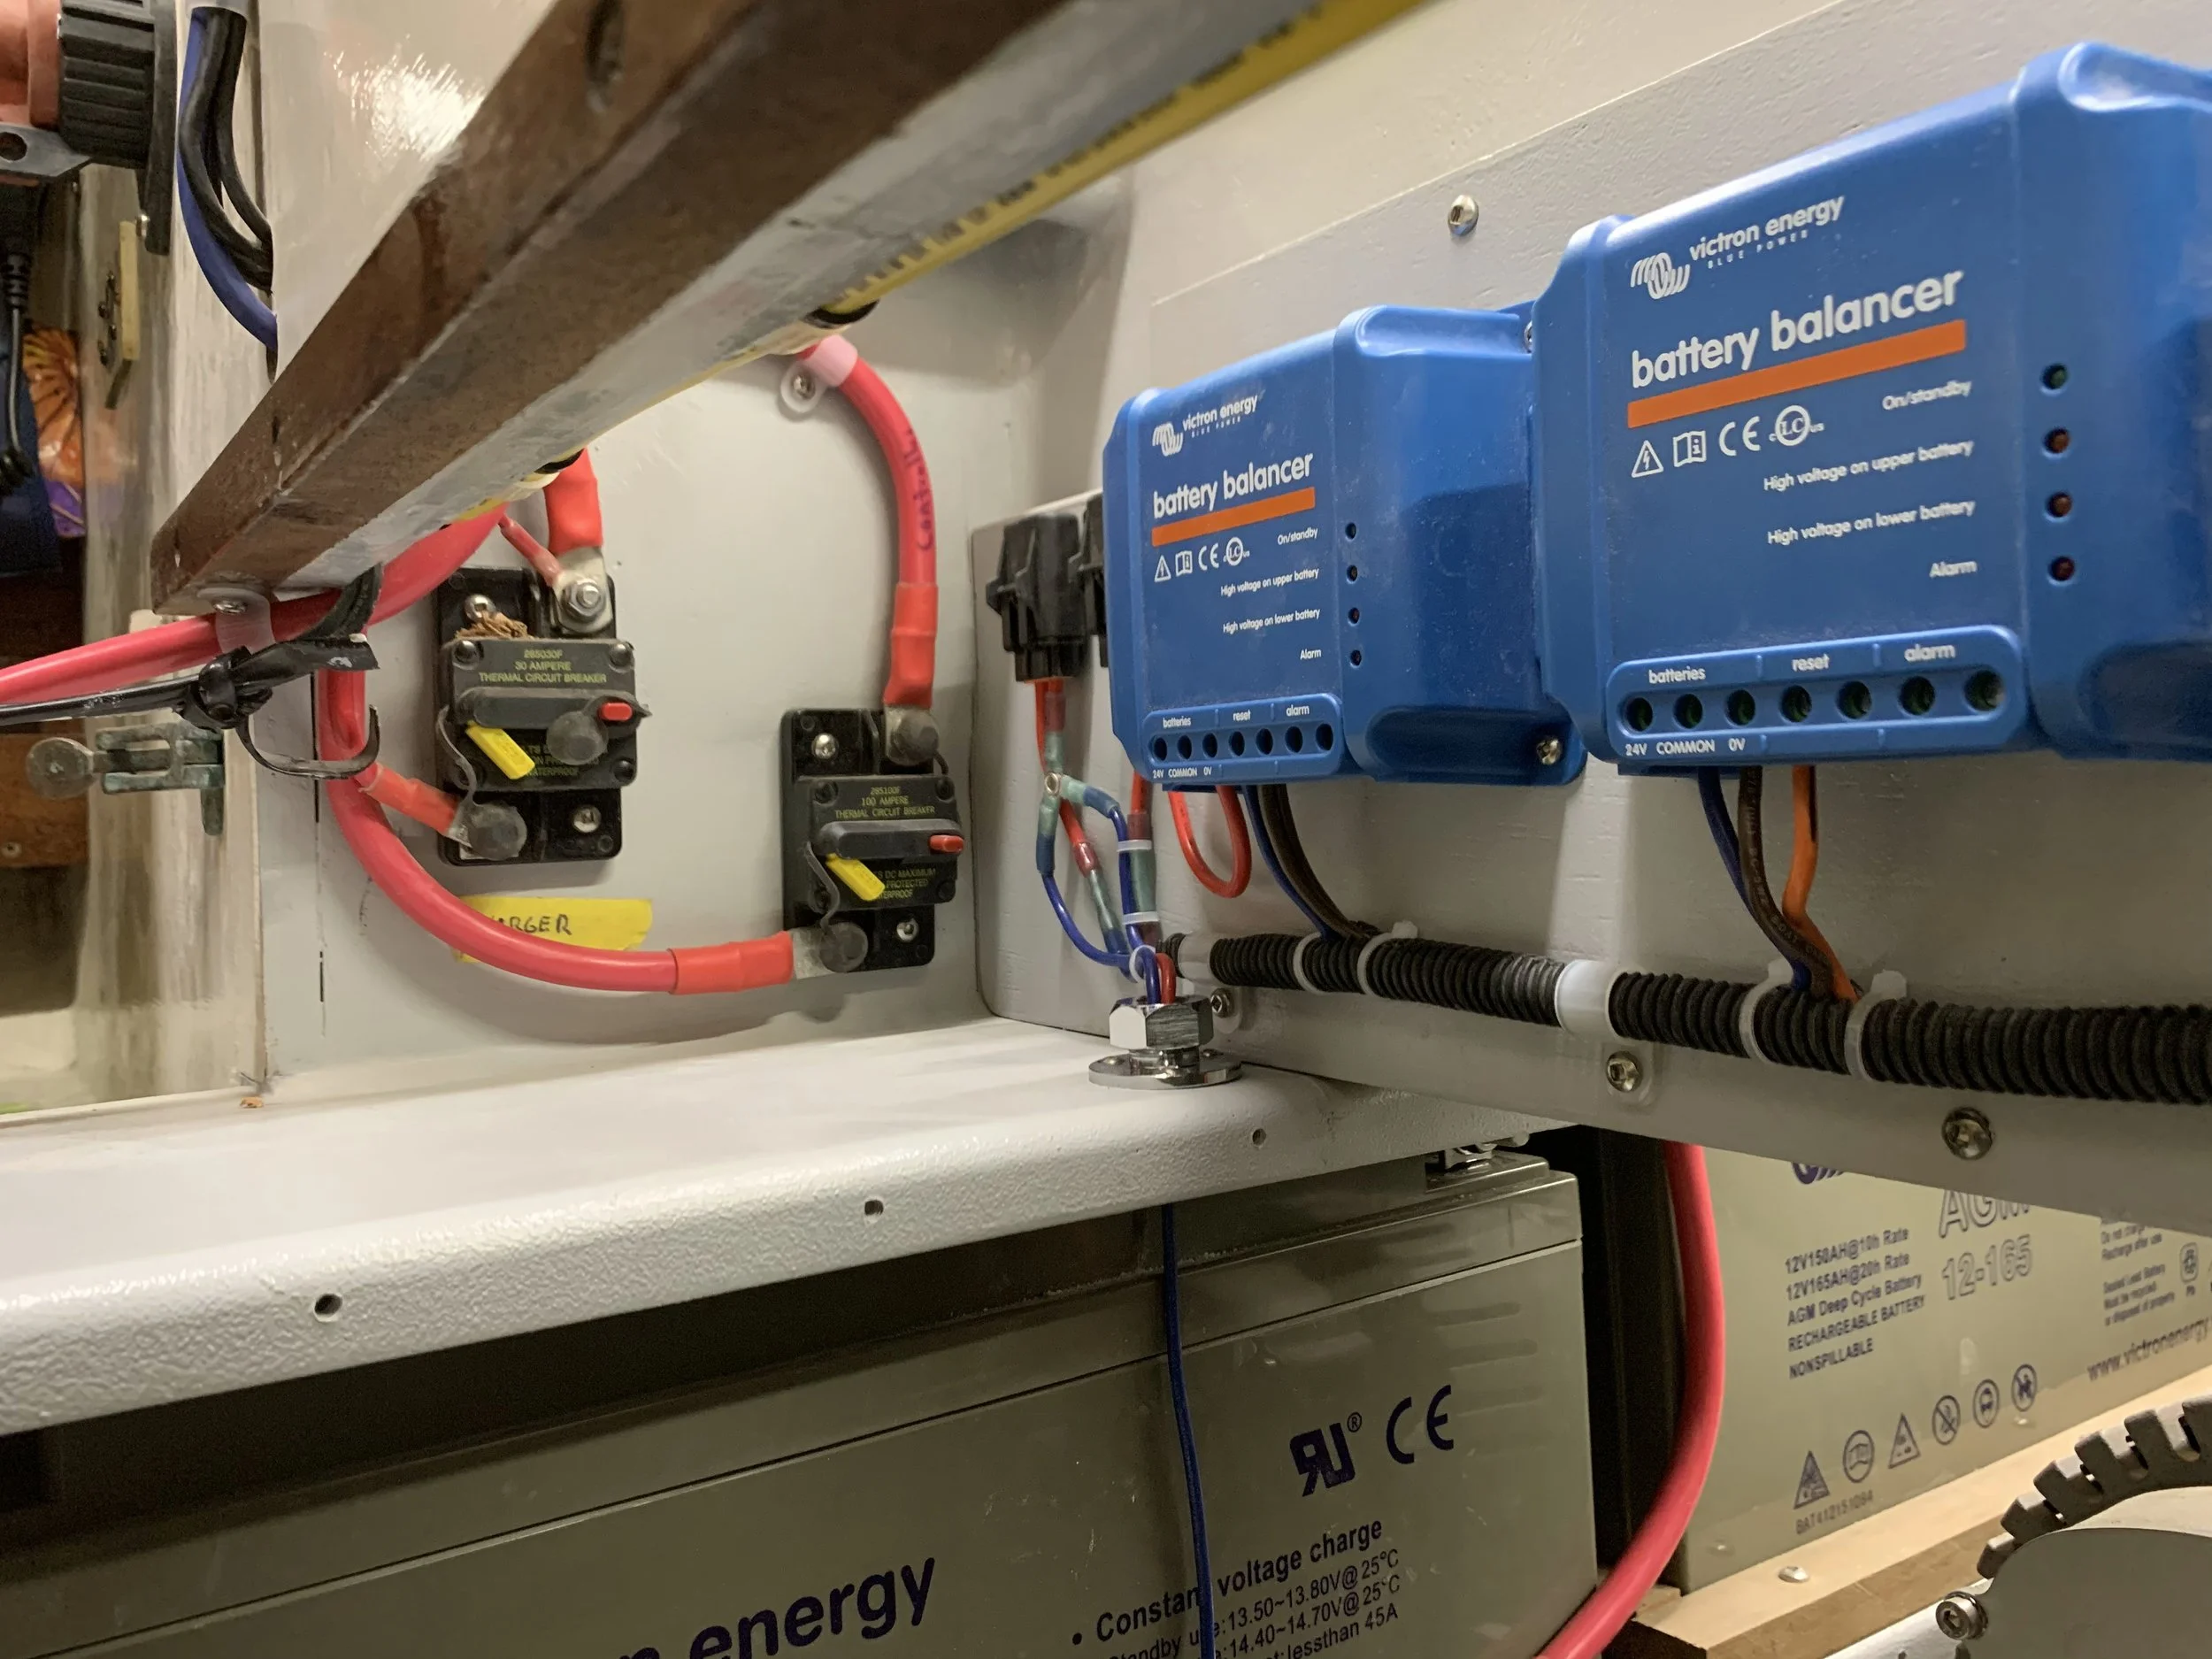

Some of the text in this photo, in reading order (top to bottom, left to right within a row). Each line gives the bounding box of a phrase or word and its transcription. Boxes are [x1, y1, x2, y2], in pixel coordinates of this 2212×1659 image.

[1689, 195, 1845, 261] victron energy
[1707, 229, 1809, 269] BLUE POWER
[1632, 270, 1963, 388] battery balancer
[1882, 380, 1972, 411] On/standby
[1182, 395, 1258, 433] victron energy
[1763, 440, 1974, 491] High voltage on upper battery
[1153, 452, 1314, 519] battery balancer
[1277, 526, 1318, 546] On/standby
[1768, 500, 1976, 545] High voltage on lower battery
[1220, 567, 1320, 597] High voltage on upper battery
[1929, 560, 1978, 578] Alarm
[1223, 608, 1321, 634] High voltage on lower battery
[529, 661, 572, 671] AMPERE
[1300, 648, 1322, 661] Alarm
[1648, 642, 1955, 686] batteries reset alarm
[479, 672, 607, 683] THERMAL CIRCUIT BREAKER
[1163, 704, 1310, 729] batteries reset alarm
[1624, 737, 1746, 757] 24V COMMON 0V
[1152, 766, 1212, 780] 24V COMMON 0V
[835, 809, 869, 818] THERMAL
[904, 806, 935, 815] BREAKER
[861, 796, 909, 806] 100 AMPERE
[1883, 1228, 1909, 1245] Rate
[1885, 1254, 1909, 1270] Rate
[1941, 1233, 2032, 1301] 12-165
[1787, 1274, 1922, 1326] AGM Deep Cycle Battery
[1788, 1294, 1925, 1352] RECHARGEABLE BATTERY
[1789, 1338, 1873, 1379] NONSPILLABLE
[1096, 1519, 1382, 1642] Constan voltage charge
[689, 1556, 936, 1659] energy
[1365, 1602, 1398, 1630] 45A
